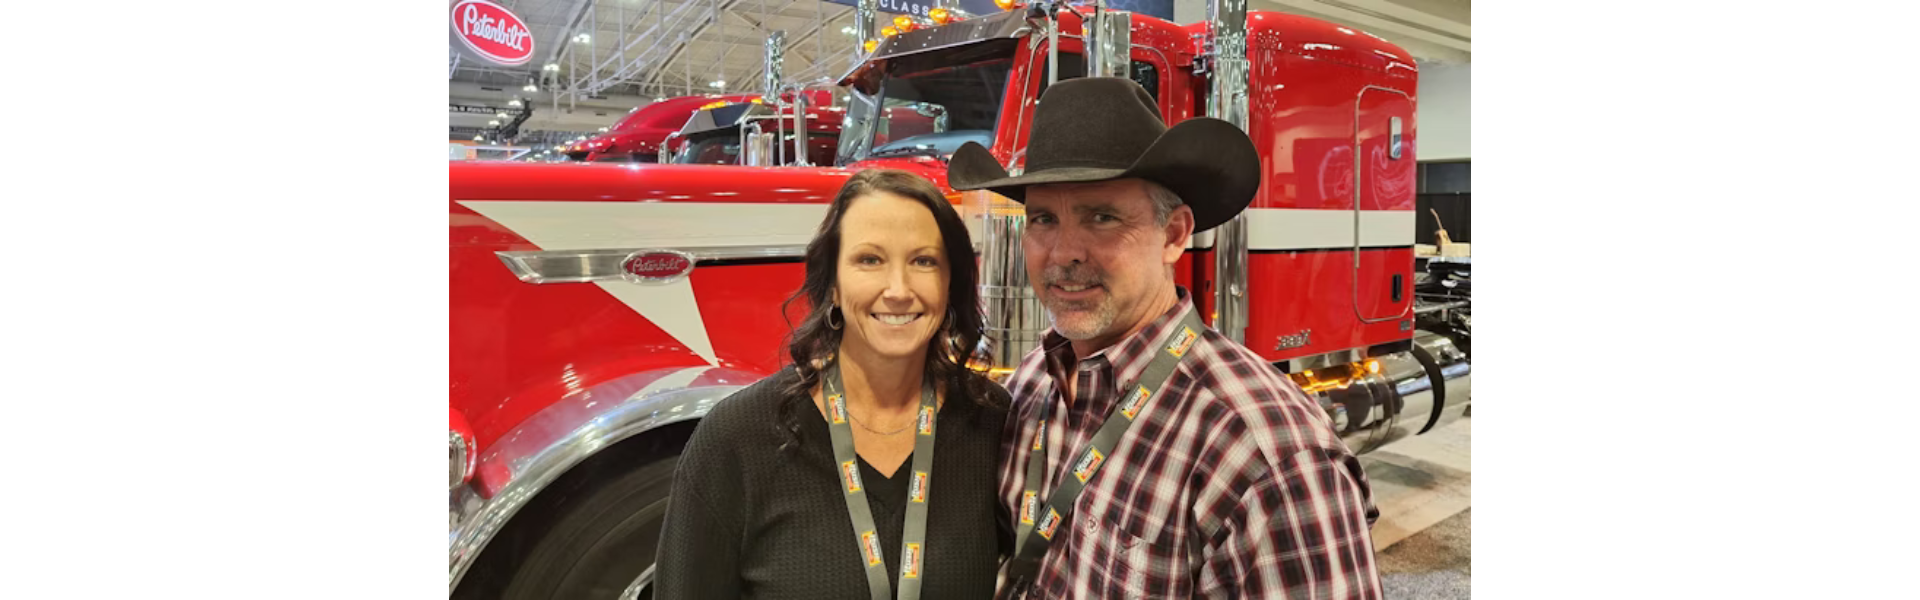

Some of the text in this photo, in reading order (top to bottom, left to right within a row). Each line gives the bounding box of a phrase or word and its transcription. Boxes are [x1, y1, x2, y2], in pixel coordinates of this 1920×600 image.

[880, 0, 929, 16] CLASS
[463, 3, 530, 52] Peterbilt
[632, 257, 684, 273] Peterbilt
